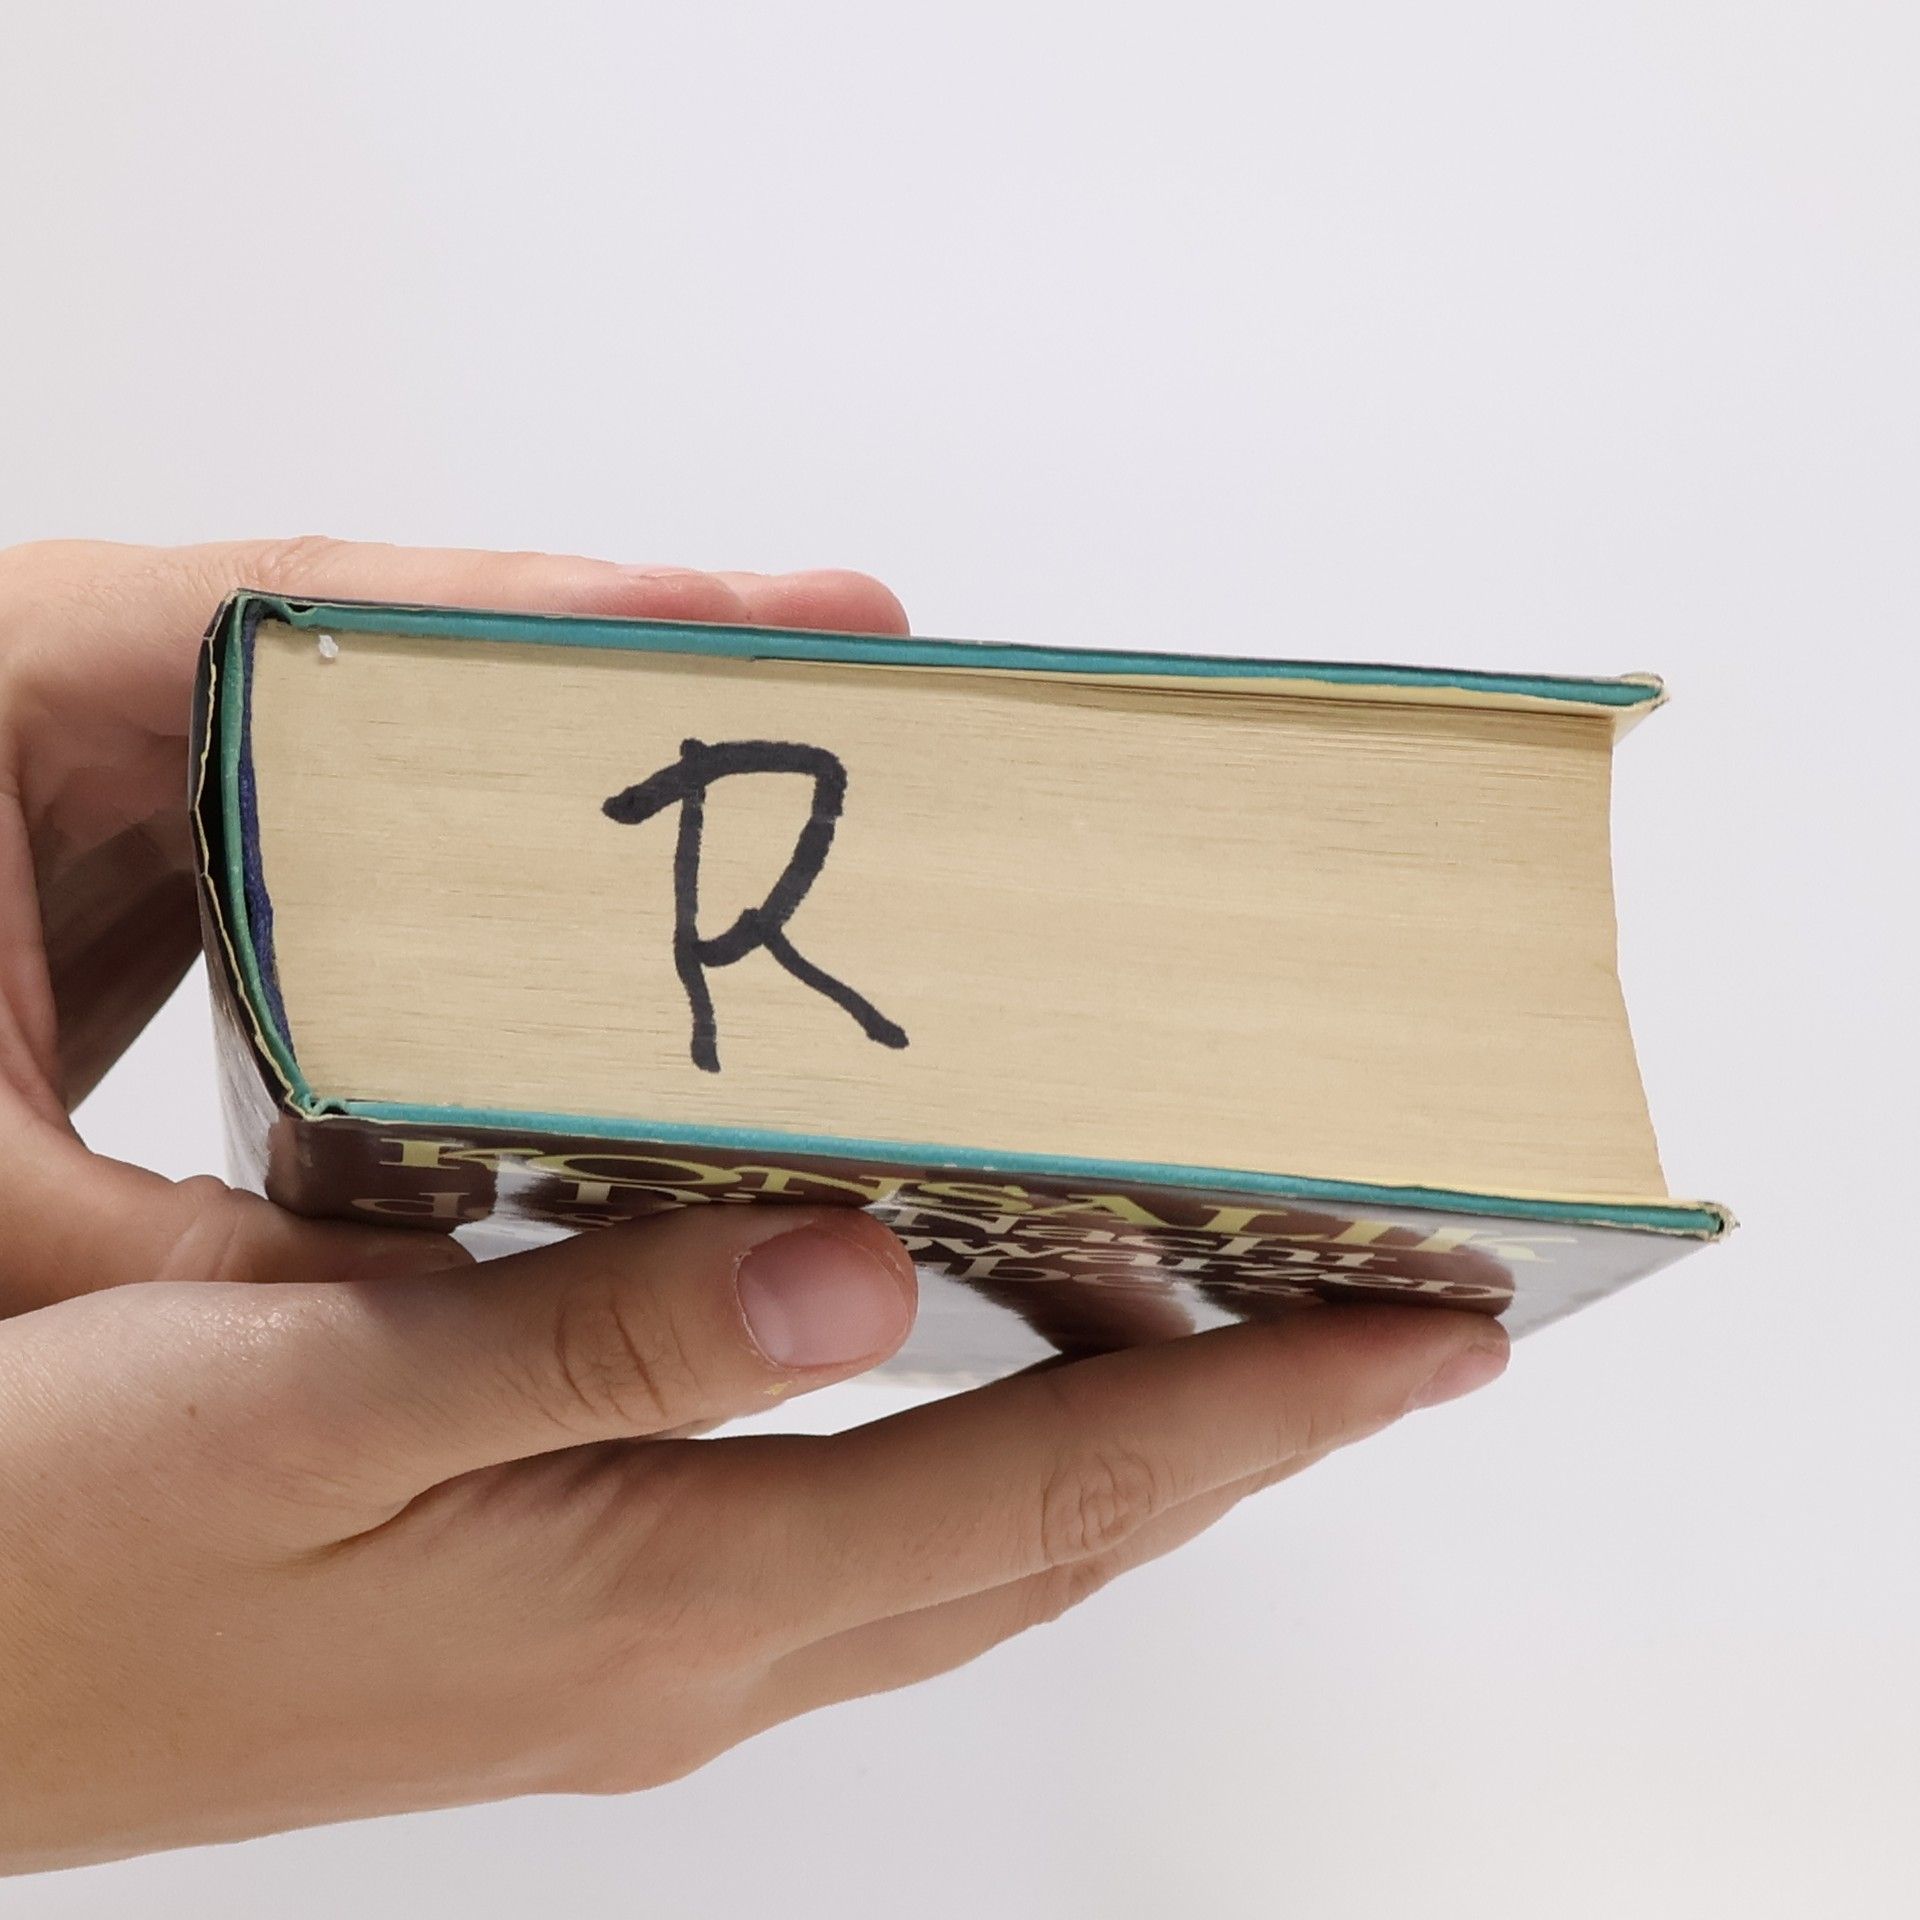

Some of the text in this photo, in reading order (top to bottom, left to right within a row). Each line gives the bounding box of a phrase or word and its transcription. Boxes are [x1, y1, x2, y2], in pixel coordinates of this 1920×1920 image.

[602, 737, 910, 1074] R
[378, 1137, 1579, 1263] KONSALIK
[868, 1202, 1398, 1271] Nacht
